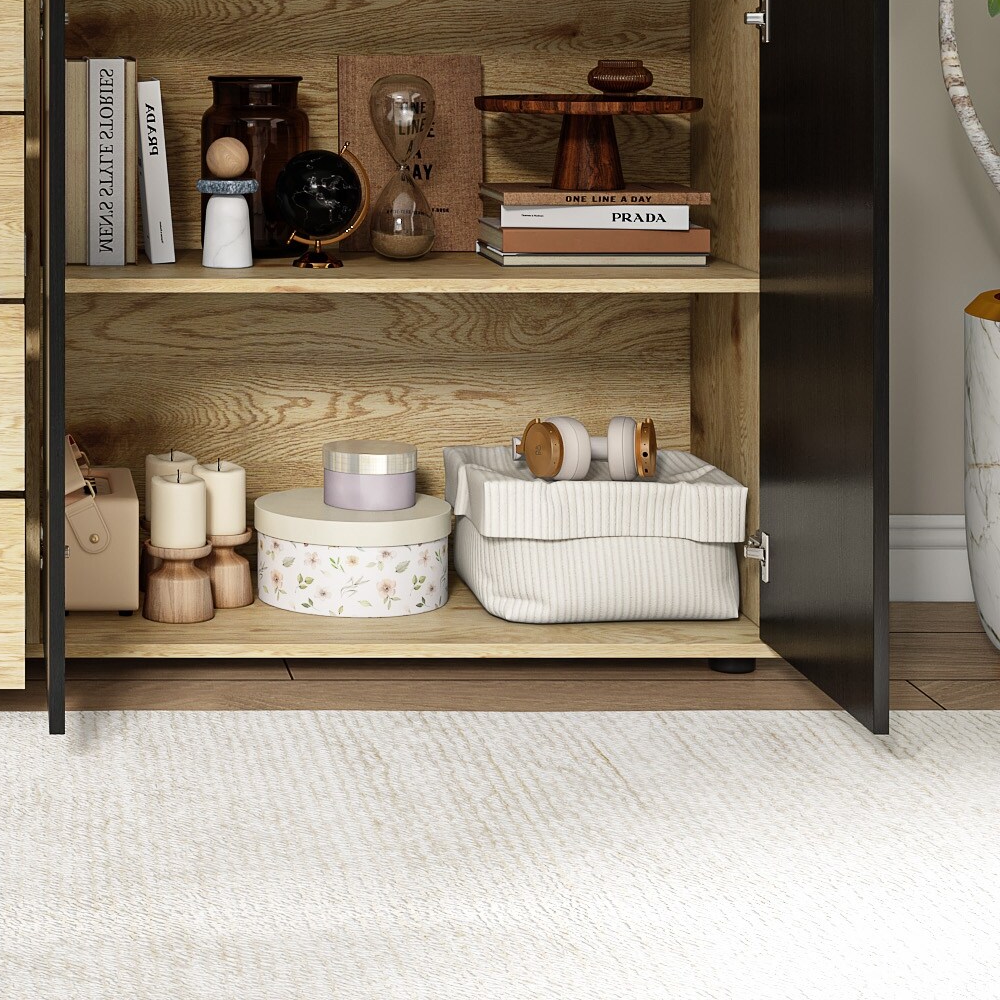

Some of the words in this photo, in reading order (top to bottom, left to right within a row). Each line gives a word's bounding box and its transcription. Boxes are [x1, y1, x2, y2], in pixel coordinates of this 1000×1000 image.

[565, 195, 587, 203] ONE
[592, 195, 617, 203] LINE
[620, 195, 628, 203] A
[630, 195, 652, 203] DAY
[612, 212, 667, 223] PRADA
